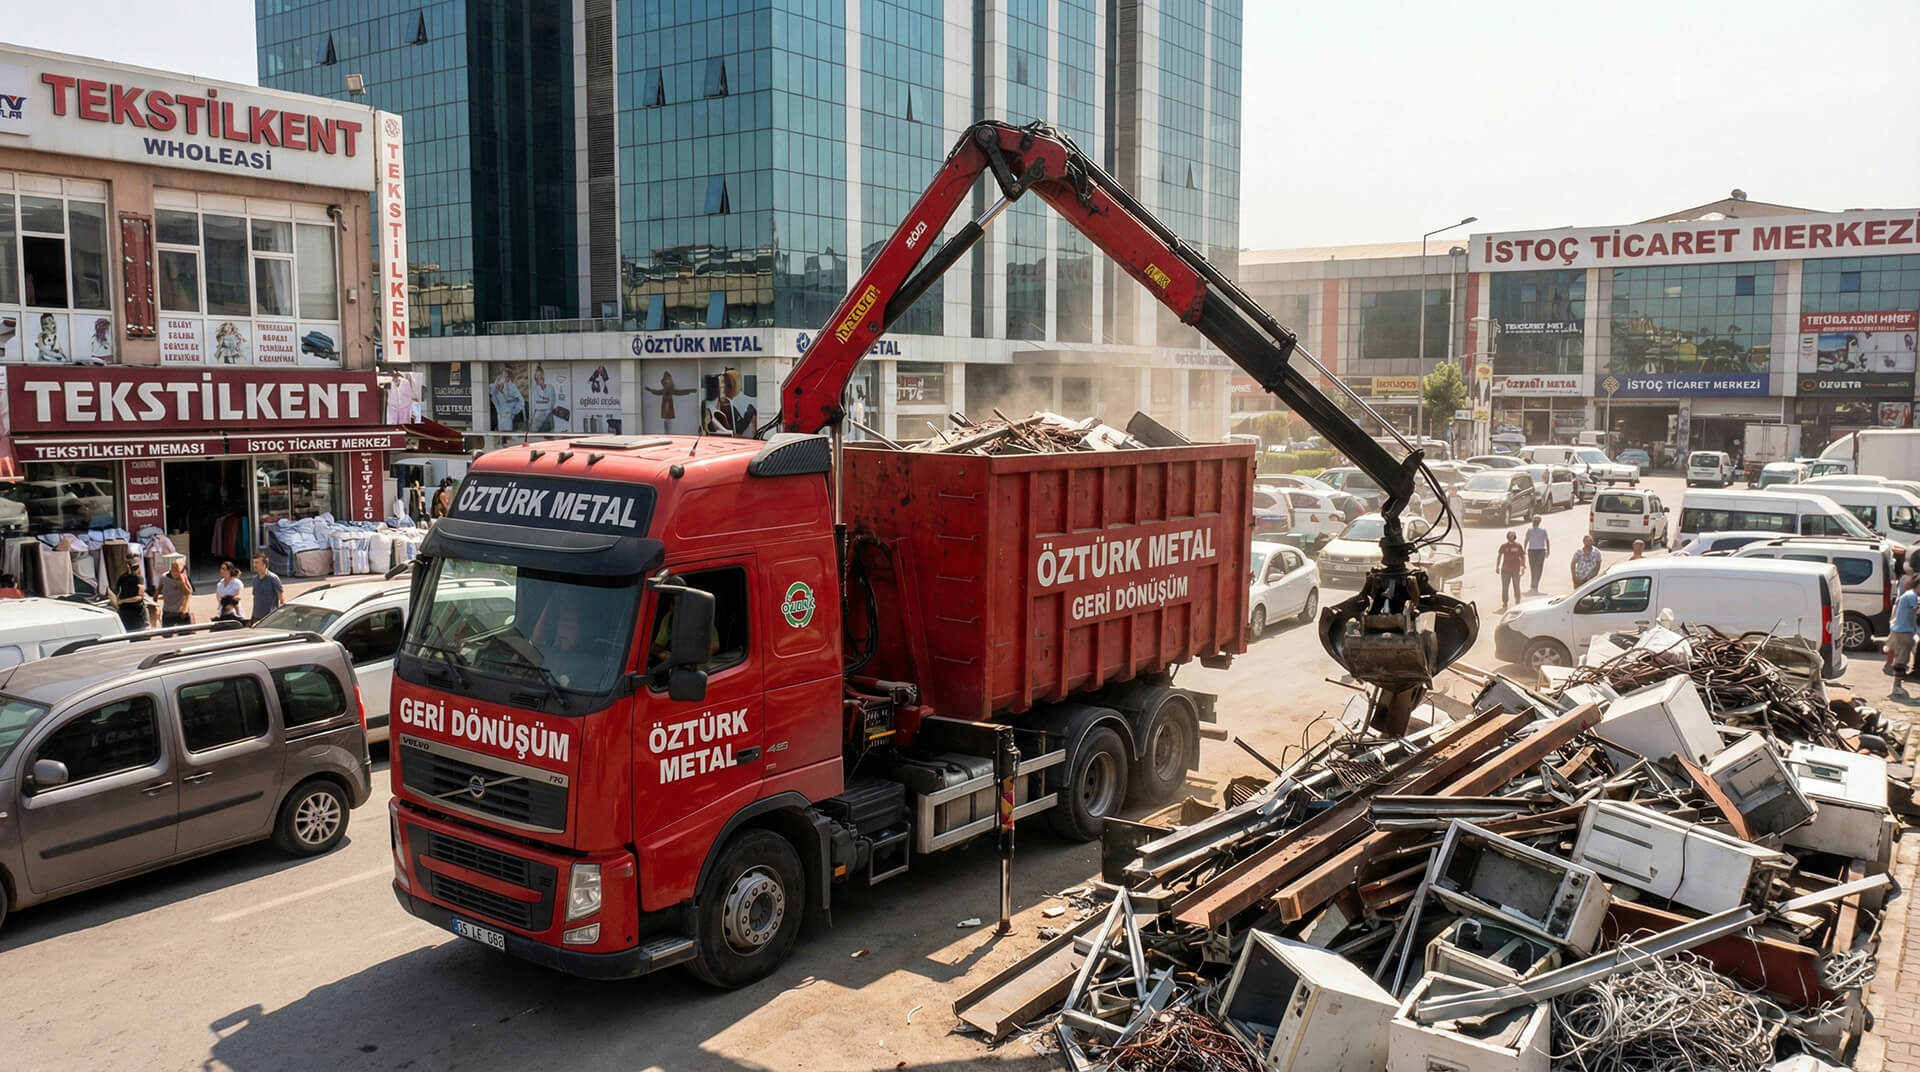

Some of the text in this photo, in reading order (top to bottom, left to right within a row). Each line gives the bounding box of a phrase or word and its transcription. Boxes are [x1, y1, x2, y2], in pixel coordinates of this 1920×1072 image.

[41, 72, 362, 157] TEKSTİLKENT
[144, 137, 272, 171] WHOLEASİ
[387, 143, 406, 356] TEKSTİLKENT
[1484, 235, 1579, 266] İSTOÇ
[1590, 229, 1740, 259] TİCARET
[644, 334, 762, 353] ÖZTÜRK METAL
[869, 340, 901, 355] ETAL
[24, 371, 368, 423] TEKSTİLKENT
[1627, 378, 1761, 392] İSTOÇ TİCARET MERKEZİ
[35, 443, 206, 459] TEKSTİLKENT MEMASI
[247, 436, 391, 453] İSTOÇ TİCARET MERKEZİ
[458, 480, 637, 528] ÖZTÜRK METAL
[1037, 527, 1216, 588] ÖZTÜRK METAL
[1072, 573, 1188, 621] GERİ DÖNÜŞÜM
[400, 697, 570, 763] GERİ DÖNÜŞÜM
[648, 707, 749, 754] ÖZTÜRK
[660, 743, 738, 785] METAL
